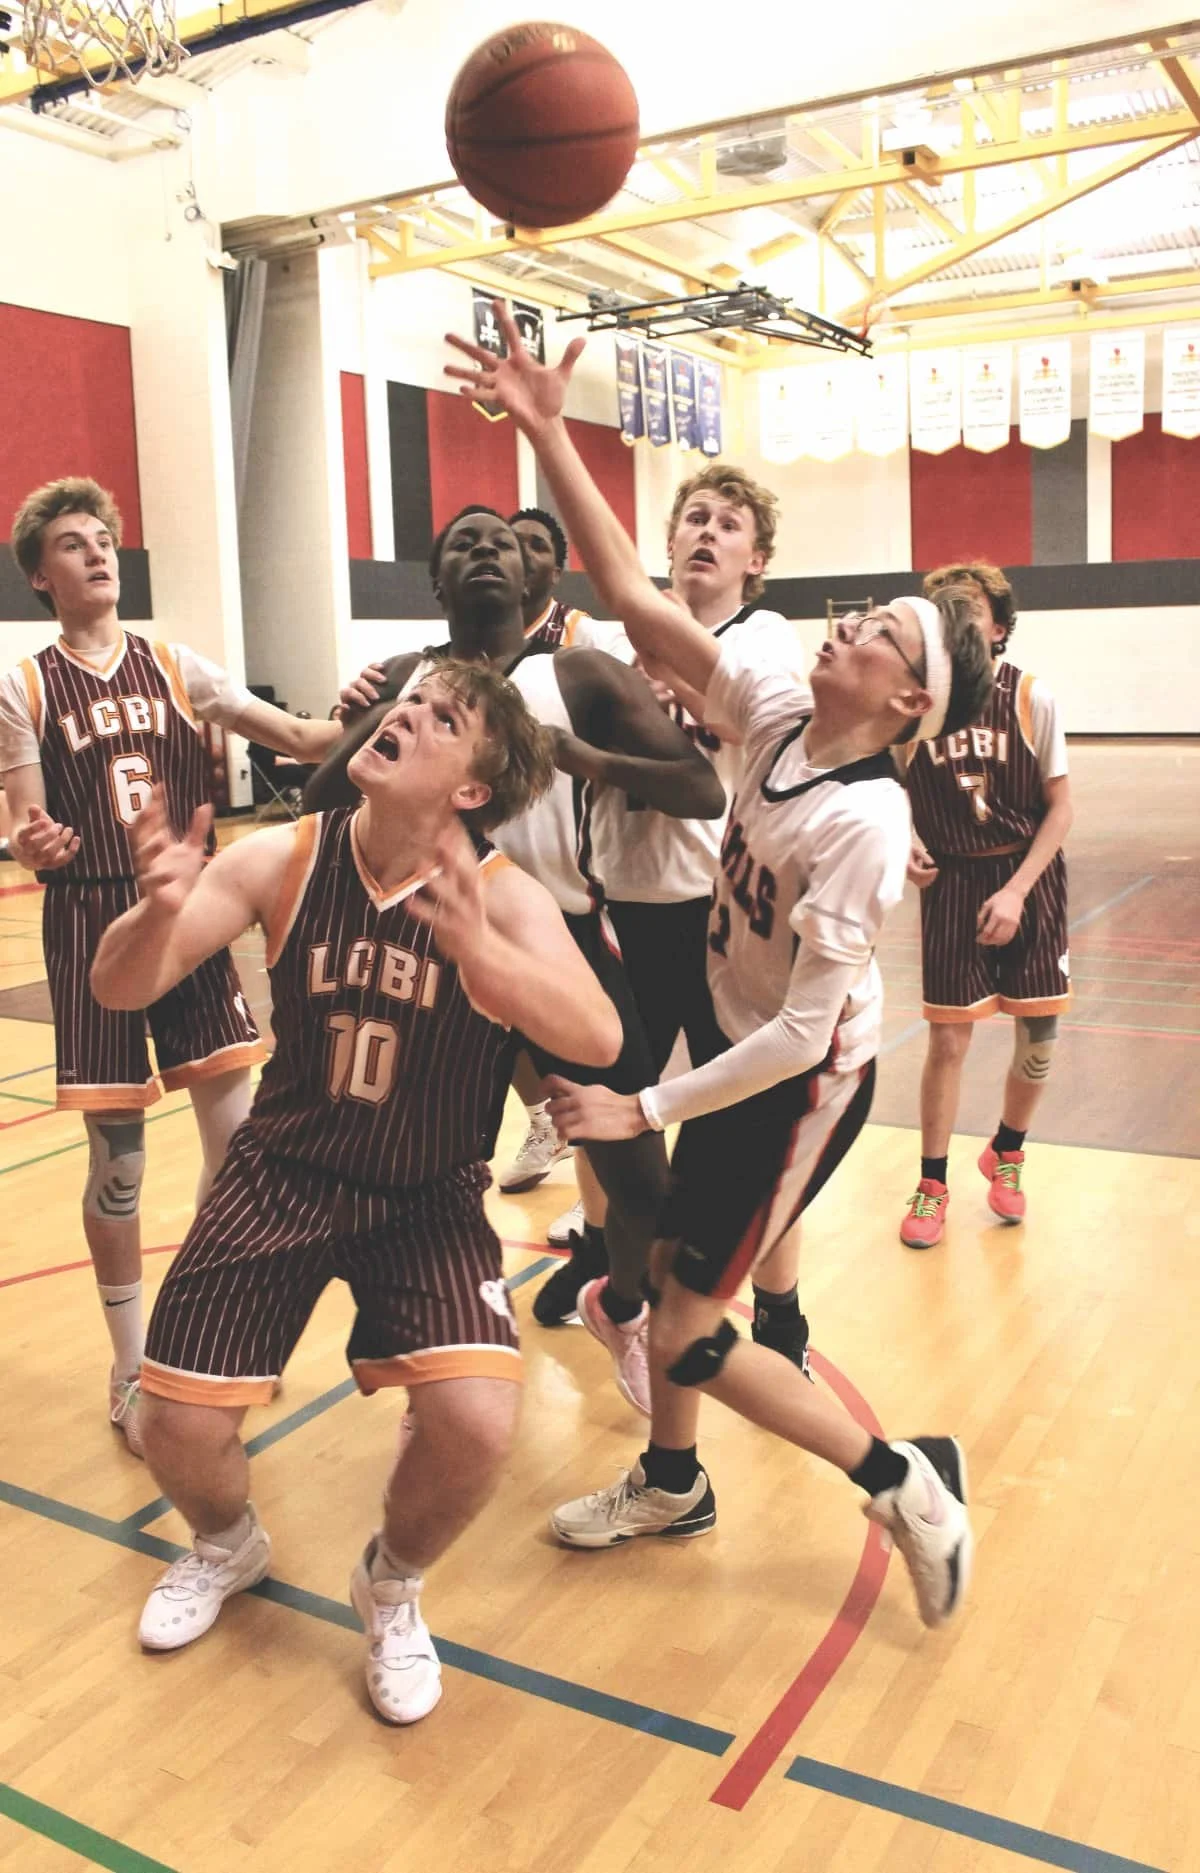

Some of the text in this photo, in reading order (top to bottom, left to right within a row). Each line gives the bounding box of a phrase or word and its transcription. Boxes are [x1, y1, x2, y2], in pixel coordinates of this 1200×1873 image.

[58, 693, 168, 755] LCBI
[924, 726, 1008, 765] LCBI
[109, 752, 153, 829] 6
[307, 936, 440, 1010] LCBI
[325, 1010, 401, 1107] 10
